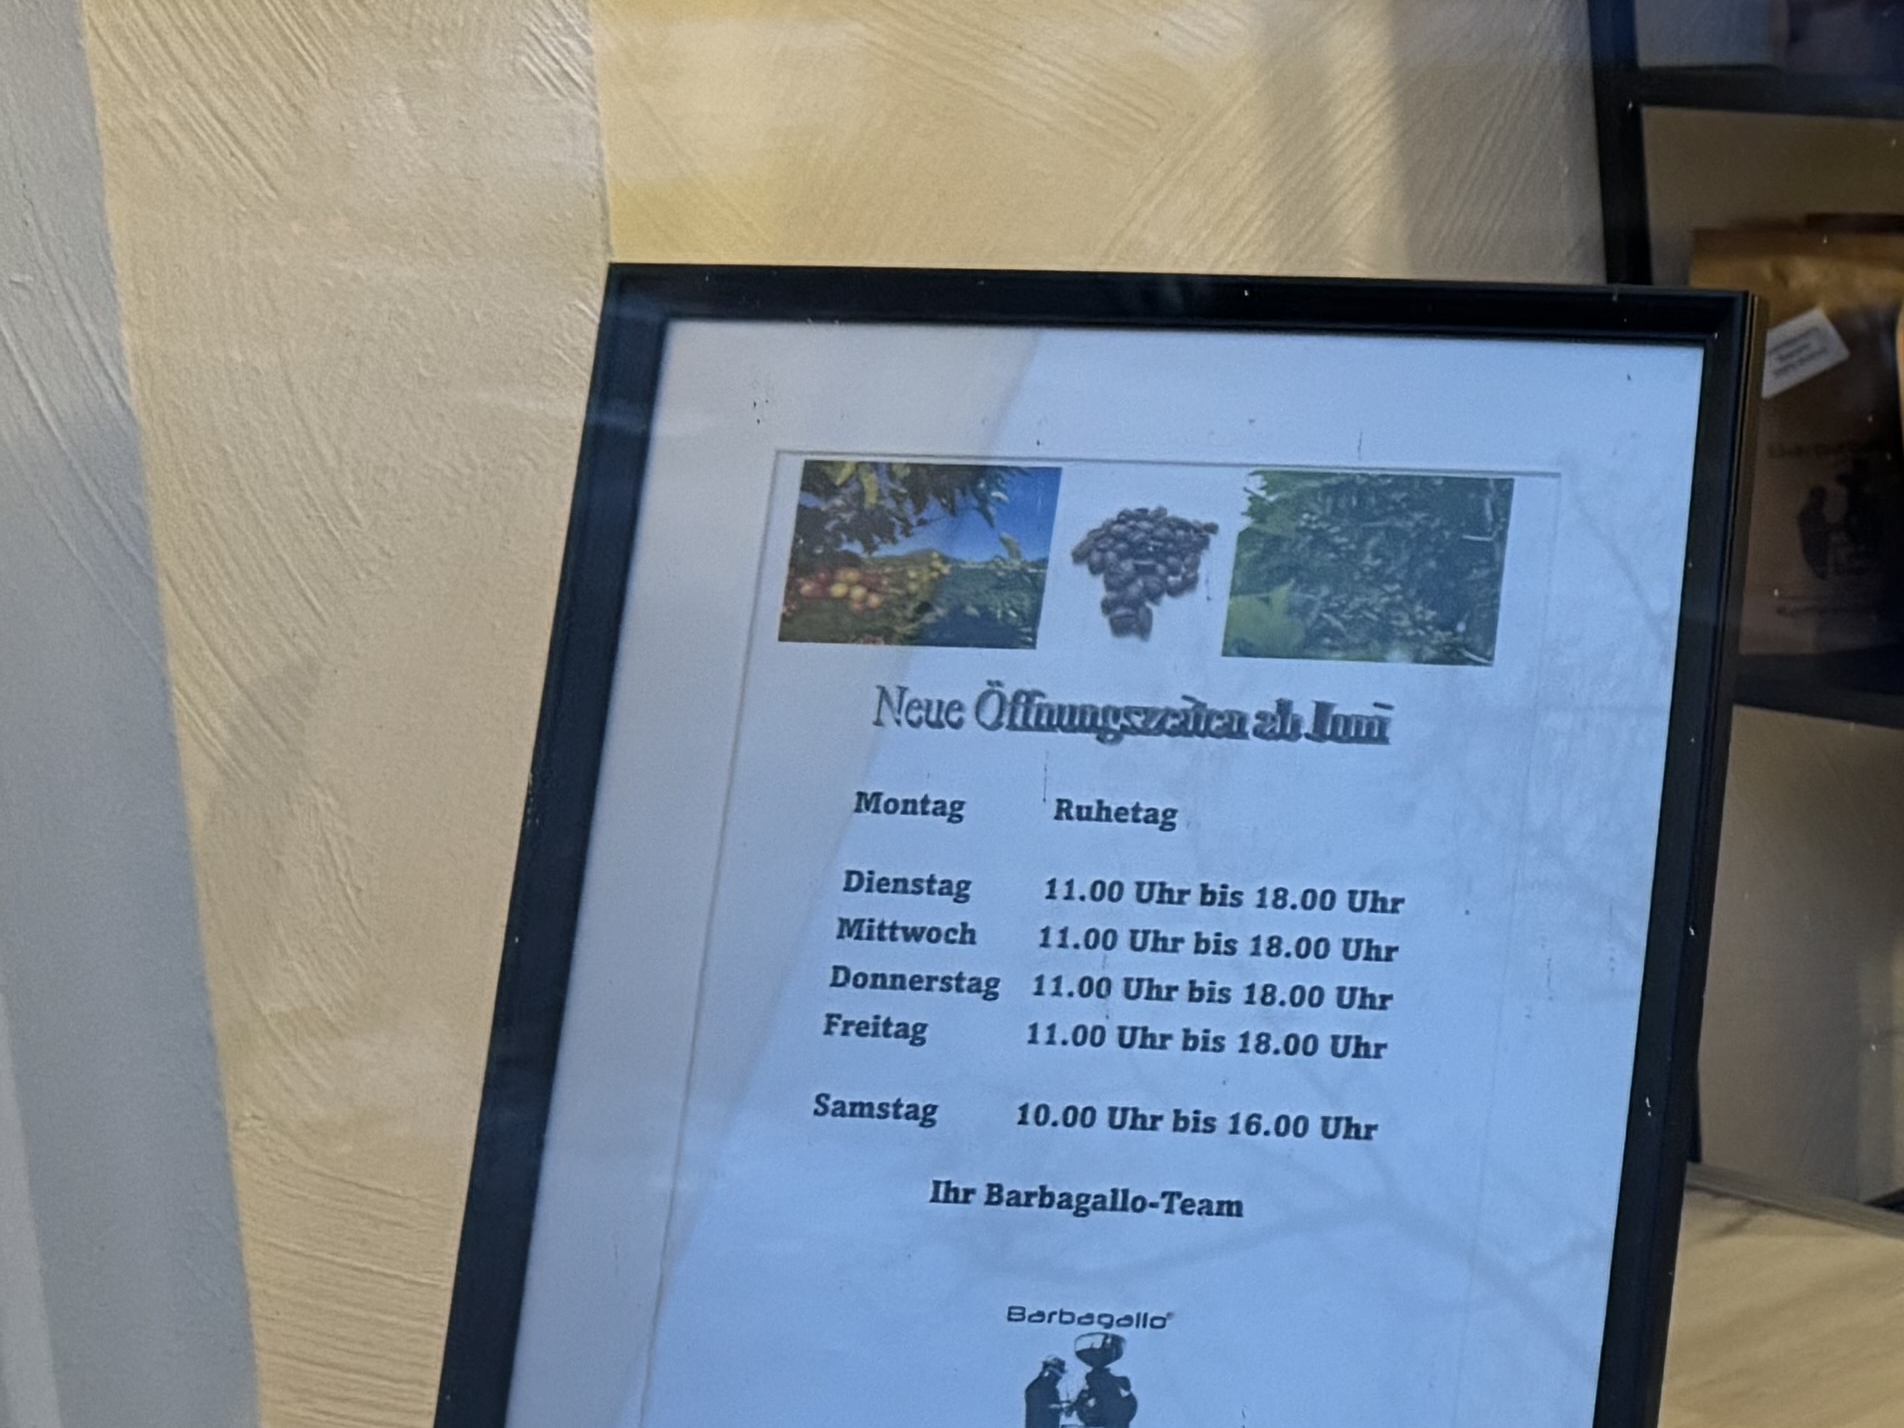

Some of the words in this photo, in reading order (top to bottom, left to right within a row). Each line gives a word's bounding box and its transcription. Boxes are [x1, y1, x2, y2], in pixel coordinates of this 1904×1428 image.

[871, 684, 966, 731] Neue
[852, 790, 966, 825] Montag
[1053, 797, 1179, 833] Ruhetag
[842, 869, 973, 904] Dienstag
[1044, 877, 1125, 904] 11.00
[1134, 880, 1192, 906] Uhr
[1199, 882, 1244, 909] bis
[1255, 886, 1337, 912] 18.00
[1347, 889, 1406, 915] Uhr
[835, 916, 977, 946] Mittwoch
[1038, 925, 1119, 952] 11.00
[1128, 928, 1186, 954] Uhr
[1193, 930, 1239, 957] bis
[1249, 934, 1331, 960] 18.00
[1341, 937, 1400, 963] Uhr
[828, 964, 1001, 1002] Donnerstag
[1032, 973, 1112, 1000] 11.00
[1123, 976, 1180, 1002] Uhr
[1187, 979, 1232, 1005] bis
[1243, 982, 1325, 1009] 18.00
[1335, 985, 1394, 1011] Uhr
[822, 1012, 929, 1048] Freitag
[1027, 1021, 1107, 1048] 11.00
[1116, 1025, 1174, 1051] Uhr
[1181, 1027, 1226, 1054] bis
[1237, 1030, 1319, 1057] 18.00
[1330, 1034, 1389, 1060] Uhr
[813, 1092, 939, 1129] Samstag
[1016, 1102, 1097, 1129] 10.00
[1107, 1105, 1164, 1132] Uhr
[1172, 1108, 1217, 1134] bis
[1227, 1111, 1310, 1139] 16.00
[1320, 1115, 1379, 1141] Uhr
[928, 1179, 977, 1205] Ihr
[983, 1182, 1244, 1218] Barbagallo-Team
[1006, 1305, 1168, 1330] Barbagallo
